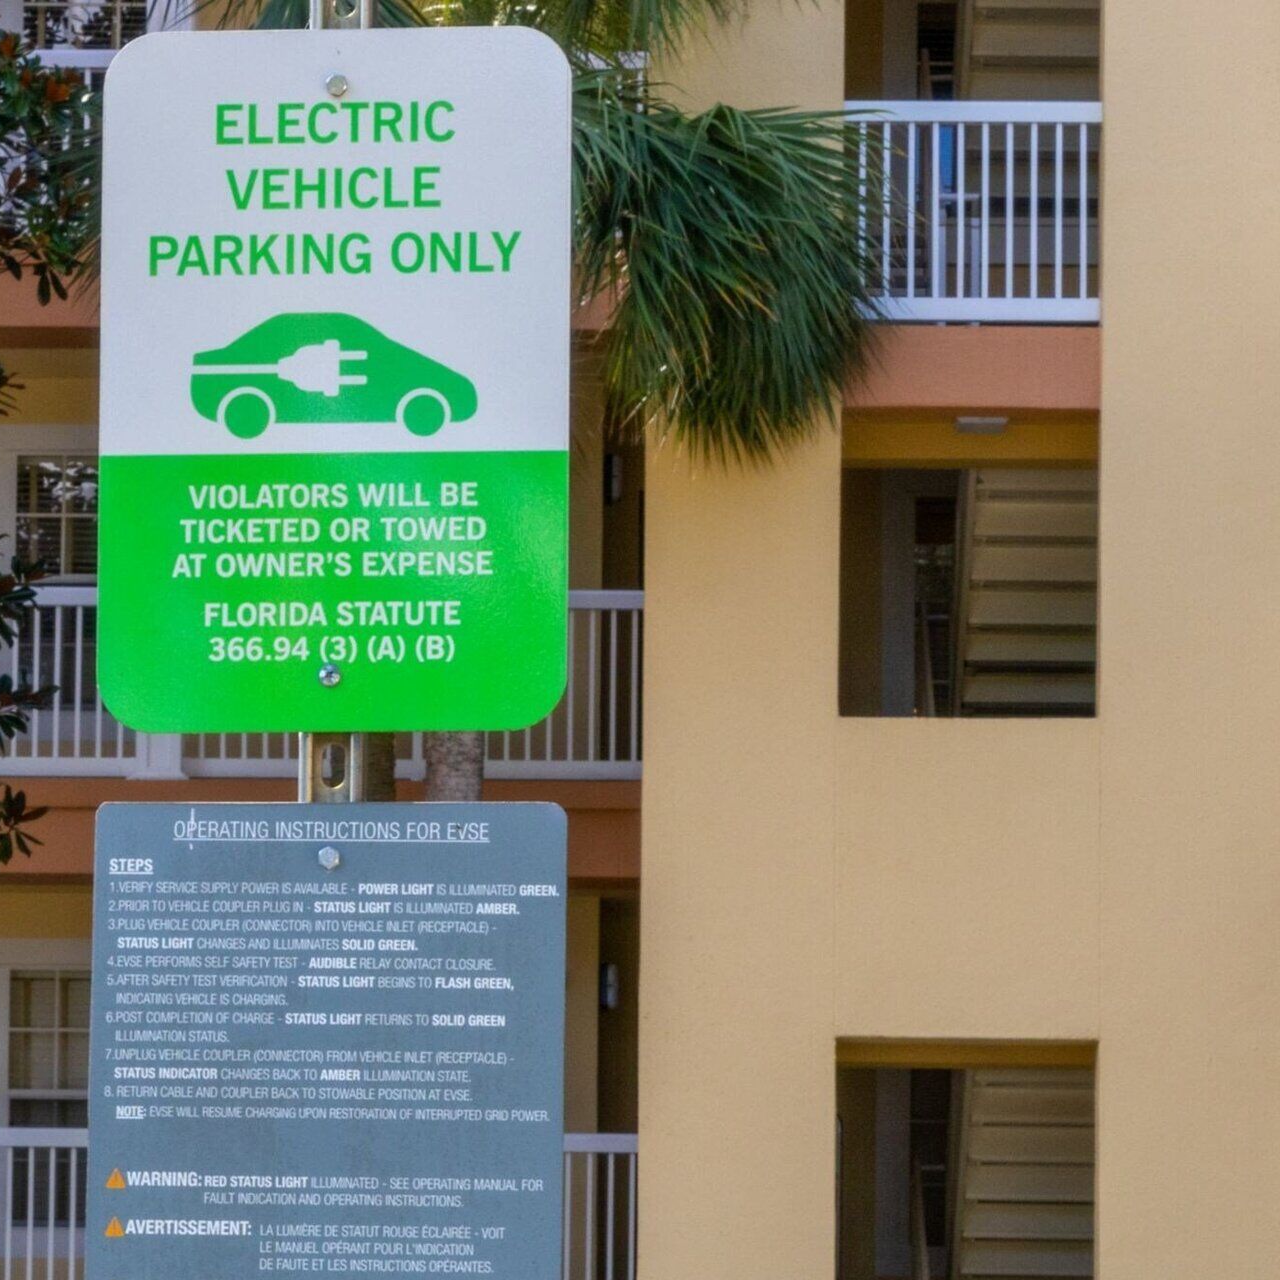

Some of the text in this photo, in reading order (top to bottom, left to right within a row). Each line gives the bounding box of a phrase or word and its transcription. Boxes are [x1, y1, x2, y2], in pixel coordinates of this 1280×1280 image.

[216, 100, 455, 145] ELECTRIC
[226, 166, 441, 211] VEHICLE
[149, 231, 521, 277] PARKING ONLY
[189, 482, 477, 510] VIOLATORS WILL BE
[181, 517, 486, 544] TICKETED OR TOWED
[173, 553, 205, 578] AT
[363, 551, 492, 577] EXPENSE
[204, 600, 460, 628] FLORIDA STATUTE
[208, 635, 454, 664] 366.94 (3) (A) (B)
[173, 820, 488, 841] OPERATING INSTRUCTIONS FOR EVSE
[109, 858, 152, 874] STEPS
[155, 881, 197, 893] SERVICE
[200, 882, 238, 893] SUPPLY
[241, 882, 279, 894] POWER
[281, 882, 292, 894] IS
[293, 882, 347, 894] AVAILABLE
[357, 883, 398, 894] POWER
[400, 883, 434, 895] LIGHT
[436, 883, 446, 895] IS
[448, 883, 516, 896] ILLUMINATED
[518, 884, 559, 896] GREEN.
[151, 900, 166, 911] TO
[167, 900, 209, 912] VEHICLE
[212, 900, 260, 912] COUPLER
[262, 900, 290, 913] PLUG
[292, 901, 303, 912] IN
[313, 901, 356, 913] STATUS
[357, 901, 391, 913] LIGHT
[393, 901, 403, 913] IS
[405, 902, 473, 914] ILLUMINATED
[475, 902, 520, 914] AMBER.
[146, 918, 189, 930] VEHICLE
[191, 918, 240, 931] COUPLER
[241, 919, 312, 931] (CONNECTOR)
[314, 919, 340, 931] INTO
[340, 920, 383, 932] VEHICLE
[385, 920, 414, 932] INLET
[417, 920, 489, 933] (RECEPTACLE)
[116, 937, 418, 951] STATUS LIGHT CHANGES AND ILLUMINATES SOLID GREEN.
[144, 955, 202, 967] PERFORMS
[204, 955, 229, 968] SELF
[231, 956, 271, 968] SAFETY
[272, 956, 298, 968] TEST
[308, 957, 357, 969] AUDIBLE
[358, 957, 392, 969] RELAY
[393, 957, 442, 970] CONTACT
[445, 958, 496, 971] CLOSURE.
[151, 974, 190, 986] SAFETY
[192, 974, 217, 986] TEST
[219, 974, 287, 987] VERIFICATION
[297, 975, 340, 987] STATUS
[342, 976, 375, 987] LIGHT
[377, 976, 416, 988] BEGINS
[418, 976, 432, 988] TO
[434, 976, 471, 988] FLASH
[473, 977, 514, 990] GREEN,
[115, 992, 287, 1005] INDICATING VEHICLE IS CHARGING.
[126, 1171, 543, 1191] WARNING: RED STATUS LIGHT ILLUMINATED SEE OPERATING MANUAL FOR
[203, 1192, 461, 1207] FAULT INDICATION AND OPERATING INSTRUCTIONS.
[125, 1219, 251, 1235] AVERTISSEMENT:
[259, 1224, 274, 1236] LA
[323, 1224, 338, 1237] DE
[340, 1225, 379, 1237] STATUT
[382, 1225, 419, 1238] ROUGE
[480, 1226, 505, 1239] VOIT
